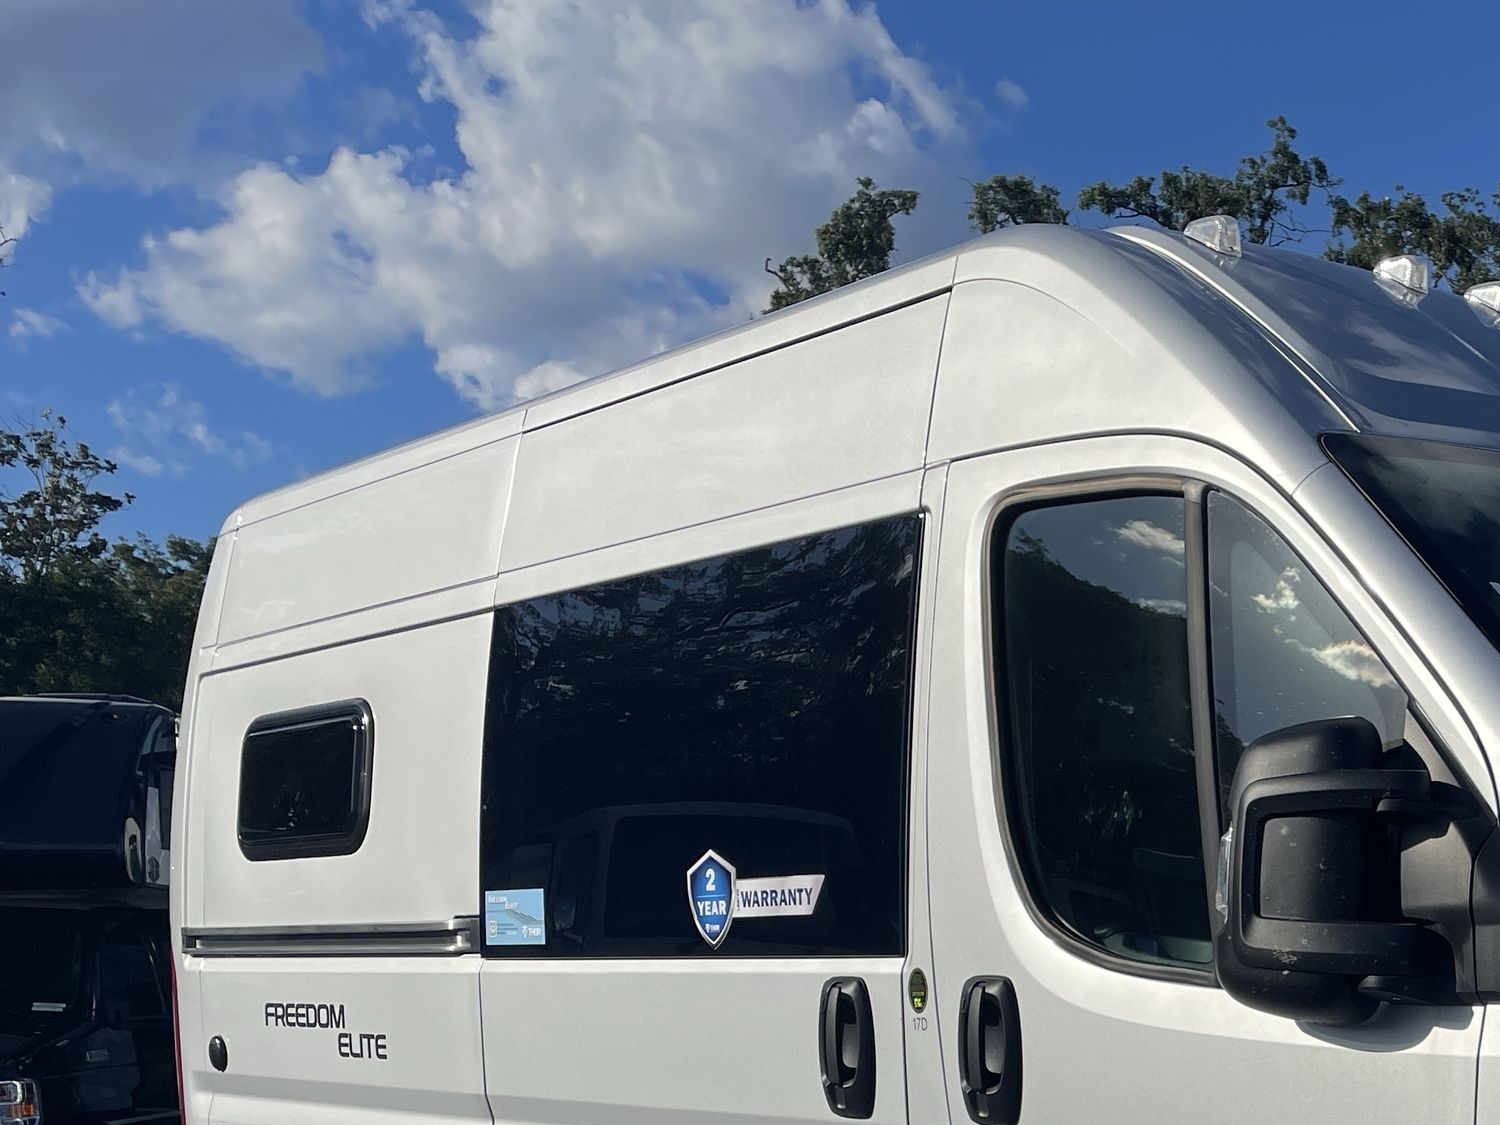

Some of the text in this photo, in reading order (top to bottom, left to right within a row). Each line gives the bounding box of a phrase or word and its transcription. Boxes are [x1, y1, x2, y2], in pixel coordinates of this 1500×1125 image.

[705, 868, 716, 891] 2
[697, 900, 727, 916] YEAR
[741, 888, 813, 908] WARRANTY
[264, 1002, 346, 1029] FREEDOM
[338, 1032, 388, 1060] ELITE
